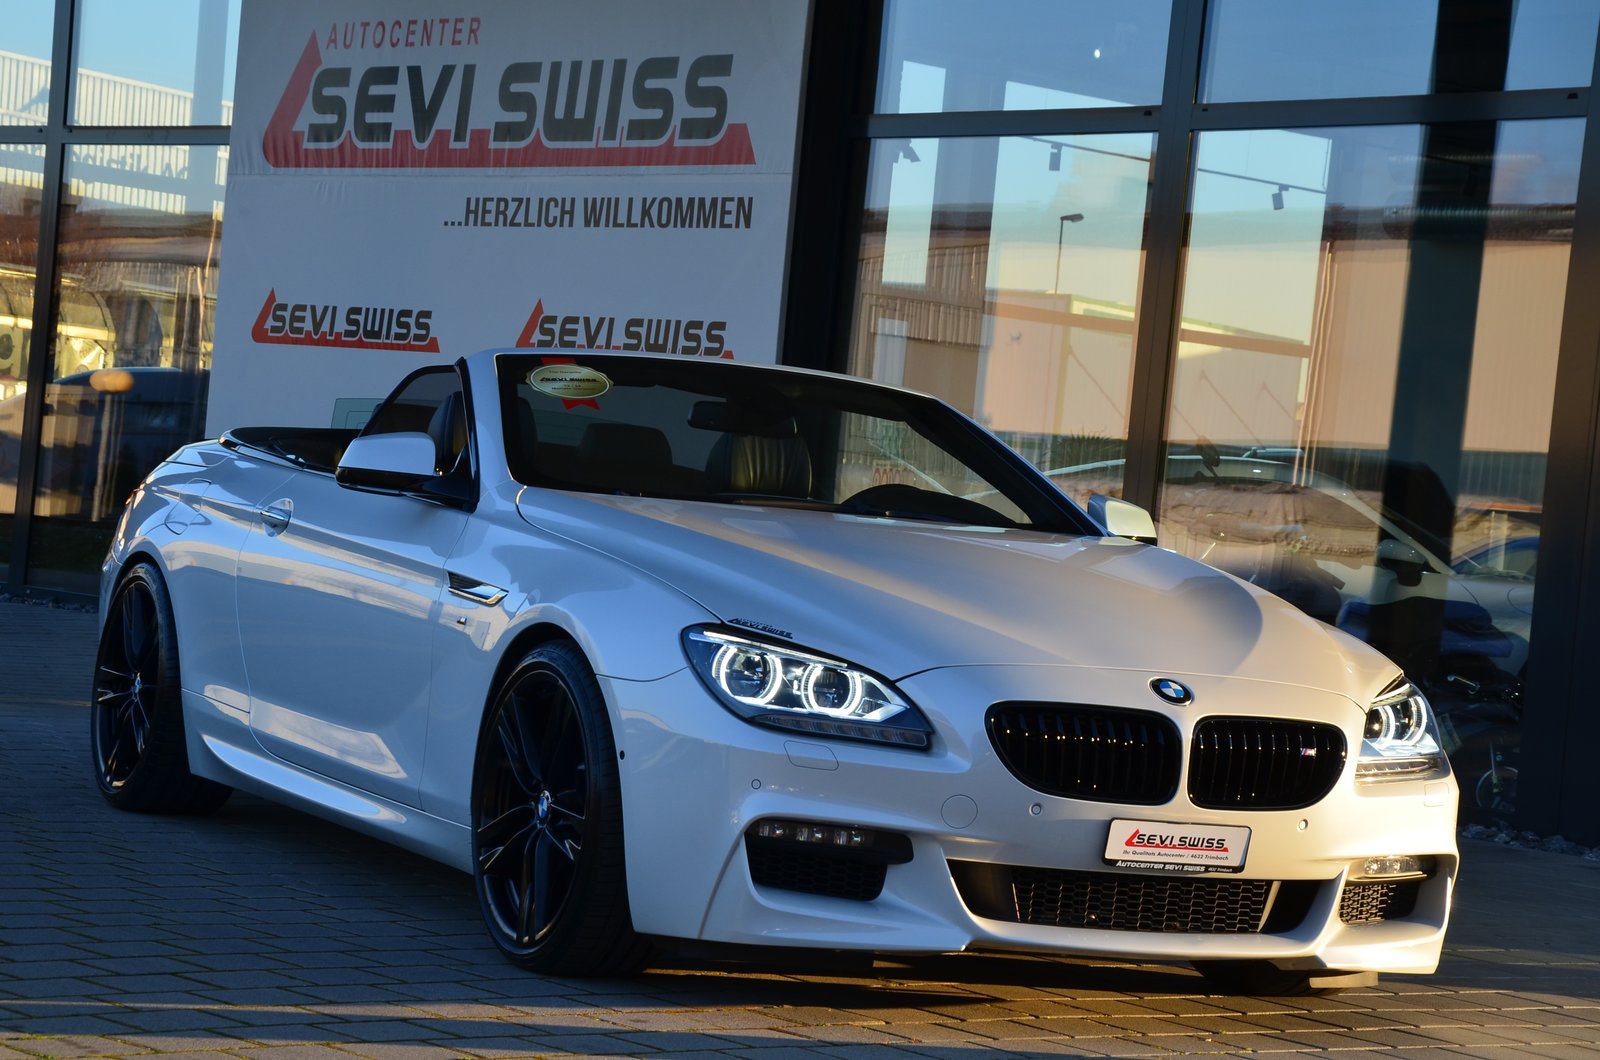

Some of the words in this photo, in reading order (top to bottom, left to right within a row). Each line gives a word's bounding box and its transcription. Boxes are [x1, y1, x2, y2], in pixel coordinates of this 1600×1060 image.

[326, 17, 481, 50] AUTOCENTER
[306, 63, 477, 144] SEVI
[493, 53, 734, 142] SWISS
[583, 196, 754, 230] WILLKOMMEN
[269, 302, 338, 338] SEVI
[343, 306, 433, 343] SWISS
[537, 315, 616, 349] SEVI
[623, 318, 727, 356] SWISS
[1135, 833, 1175, 846] SEVI
[1178, 836, 1226, 849] SWISS
